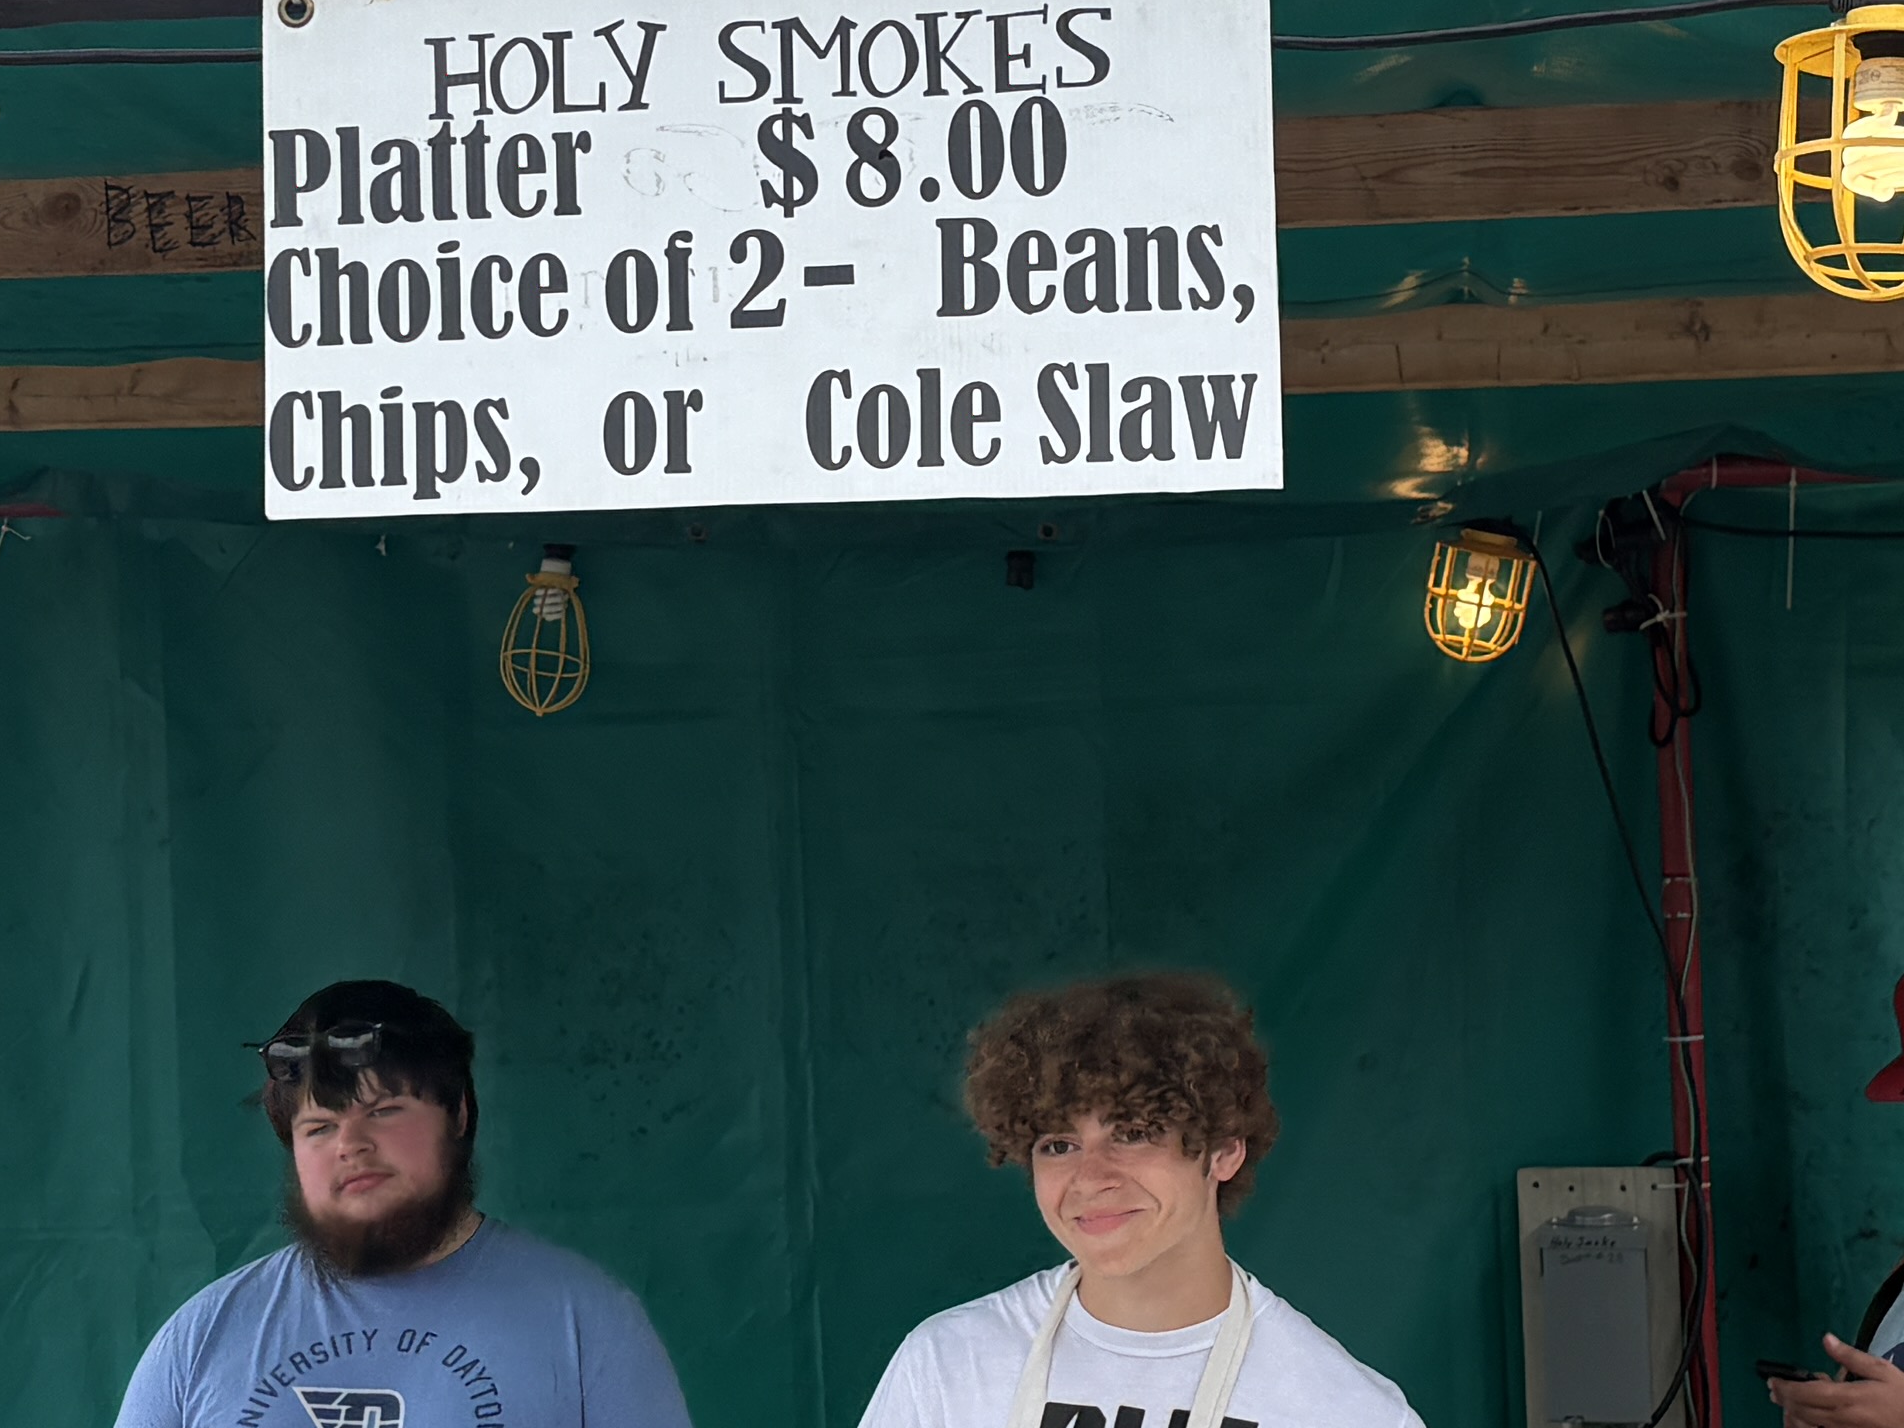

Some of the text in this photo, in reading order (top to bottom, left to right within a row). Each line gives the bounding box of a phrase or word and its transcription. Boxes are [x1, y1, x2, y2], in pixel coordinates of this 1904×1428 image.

[425, 6, 1112, 121] HOLY SMOKES
[104, 179, 257, 254] BEER
[269, 119, 591, 229] Platter
[267, 241, 570, 349] Choice
[606, 231, 696, 333] of
[936, 217, 1257, 325] Beans,
[269, 363, 1258, 501] Chips, or Cole Slaw
[397, 1328, 438, 1354] OF
